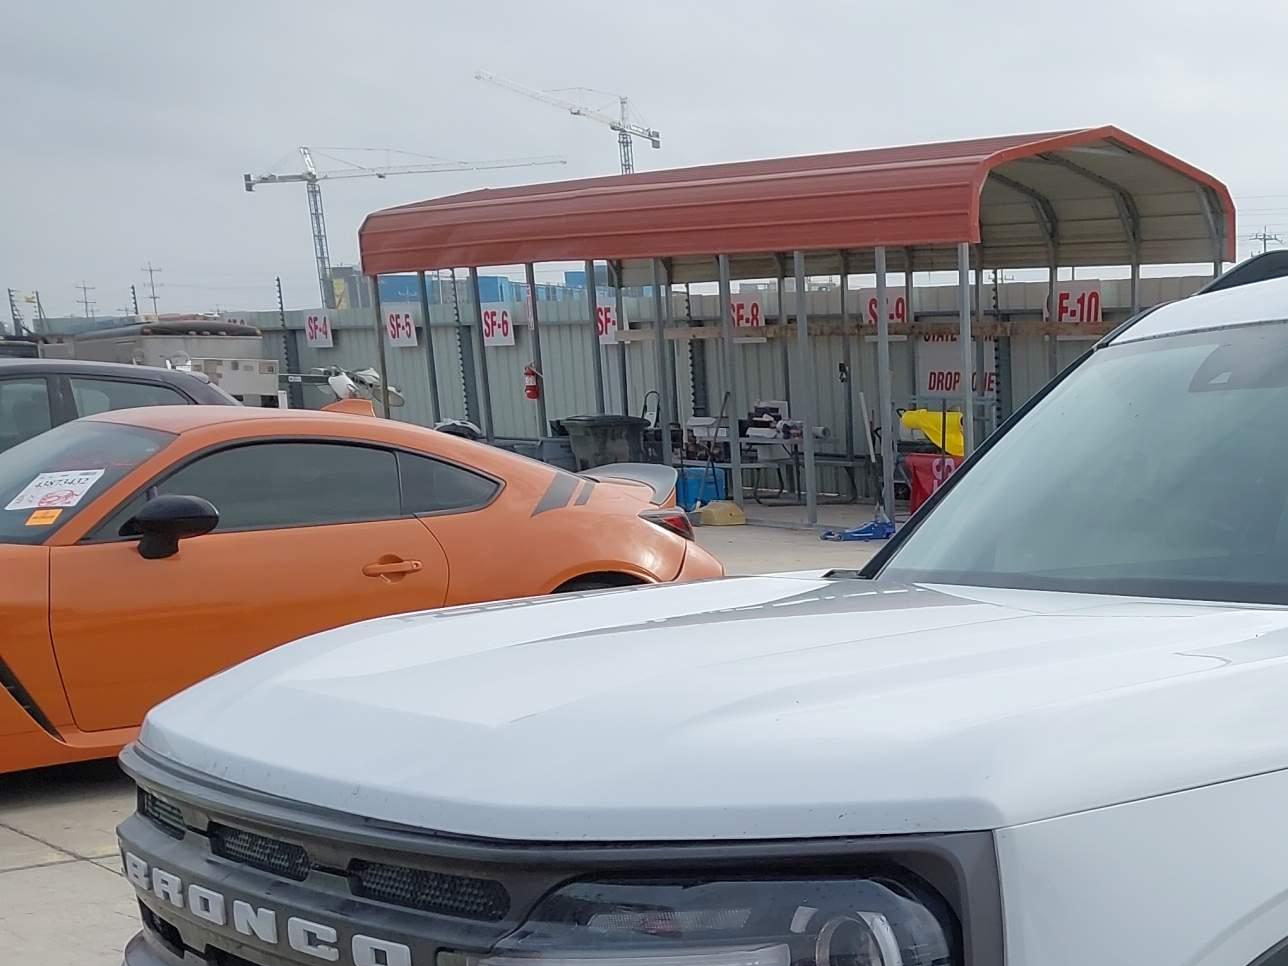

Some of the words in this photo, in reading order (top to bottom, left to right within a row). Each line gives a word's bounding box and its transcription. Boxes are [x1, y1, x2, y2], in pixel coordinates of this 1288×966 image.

[483, 310, 509, 338] SF-6
[868, 297, 907, 326] S-9
[307, 315, 329, 341] SF-4
[388, 313, 412, 340] SF-5
[928, 371, 961, 392] DROP
